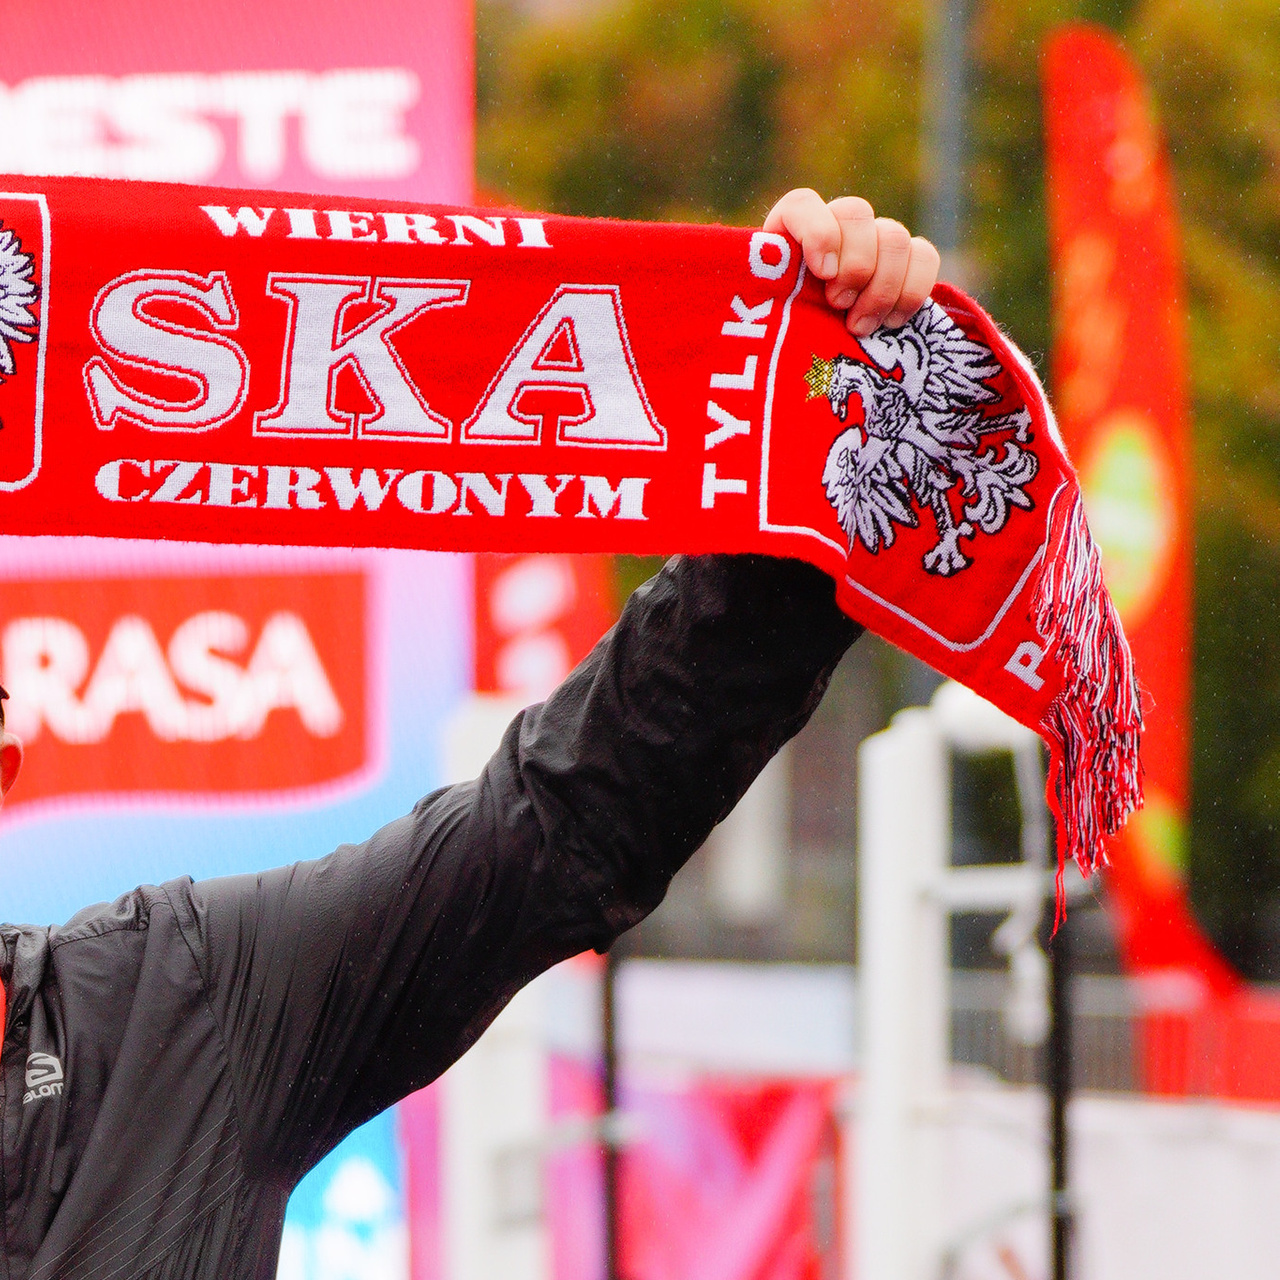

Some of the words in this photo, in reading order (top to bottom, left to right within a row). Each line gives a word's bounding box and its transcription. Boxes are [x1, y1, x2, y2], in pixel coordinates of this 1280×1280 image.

[198, 204, 554, 248] WIERNI
[83, 268, 668, 451] SKA
[701, 231, 791, 509] TYLKO
[95, 458, 652, 520] CZERWONYM
[0, 610, 344, 745] RASA
